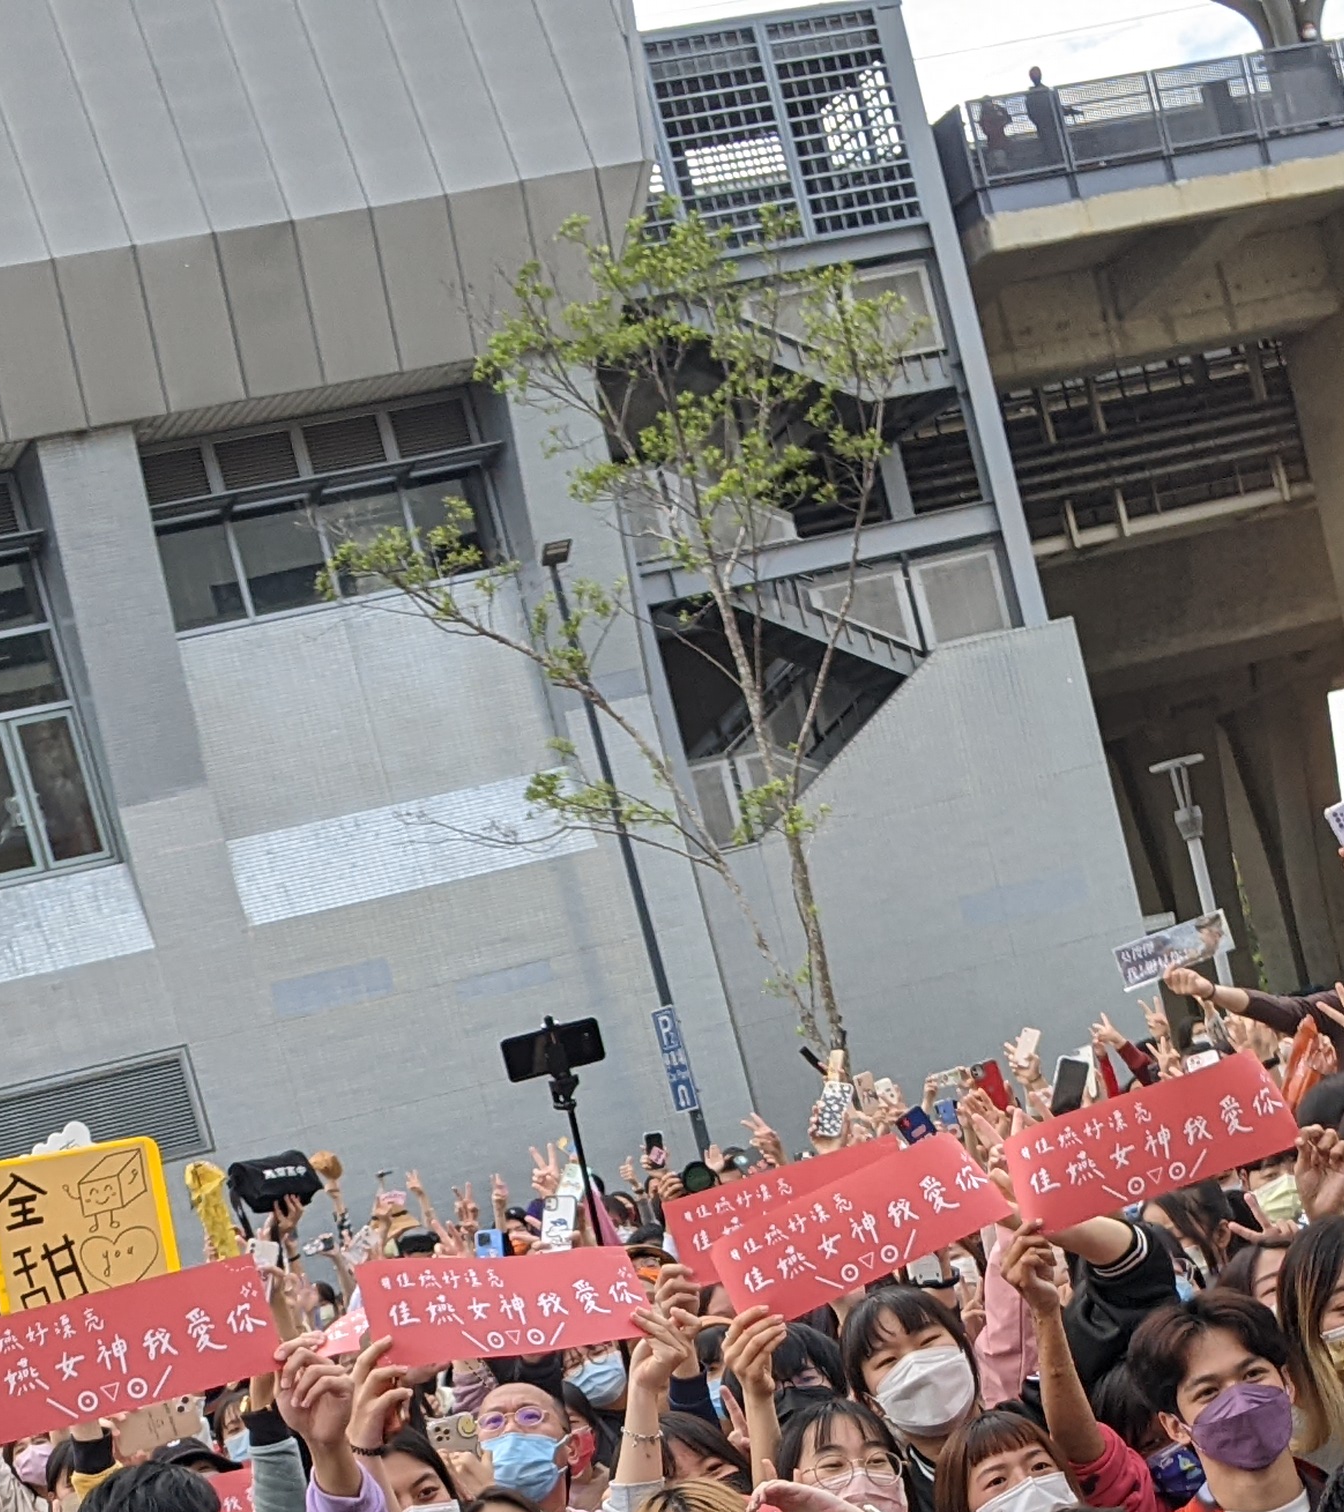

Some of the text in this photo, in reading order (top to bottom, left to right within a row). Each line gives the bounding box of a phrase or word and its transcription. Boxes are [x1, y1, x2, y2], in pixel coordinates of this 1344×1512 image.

[1029, 1088, 1283, 1195] 佳嬿女神我愛你
[102, 1246, 134, 1278] you
[745, 1166, 988, 1292] 佳嬿女神我愛你
[389, 1279, 643, 1327] 佳嬿女神我愛你
